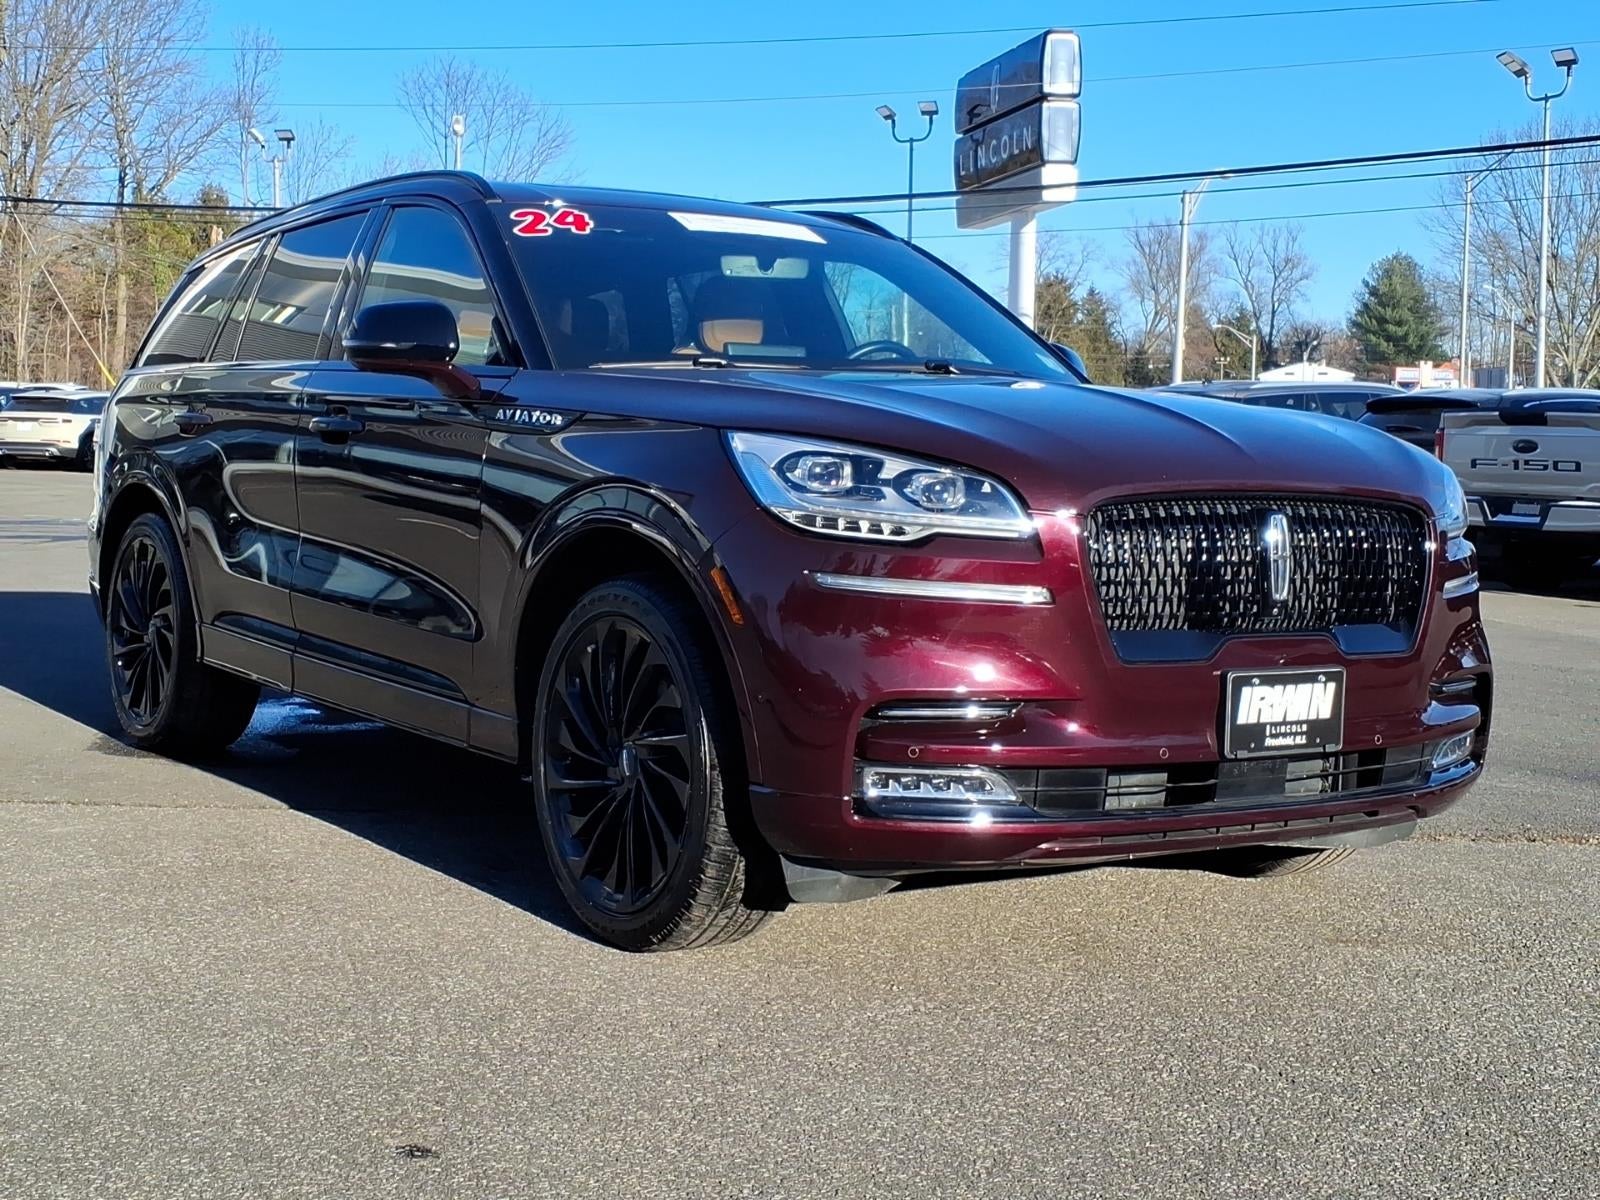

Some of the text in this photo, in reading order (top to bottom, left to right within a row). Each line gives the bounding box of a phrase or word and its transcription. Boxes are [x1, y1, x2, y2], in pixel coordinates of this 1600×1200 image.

[959, 125, 1032, 175] LINCOLN
[510, 208, 594, 236] 24
[495, 409, 563, 425] AVIATOR
[1470, 458, 1582, 473] F-150
[1236, 682, 1336, 724] IRWIN
[1271, 724, 1307, 734] LINCOLN
